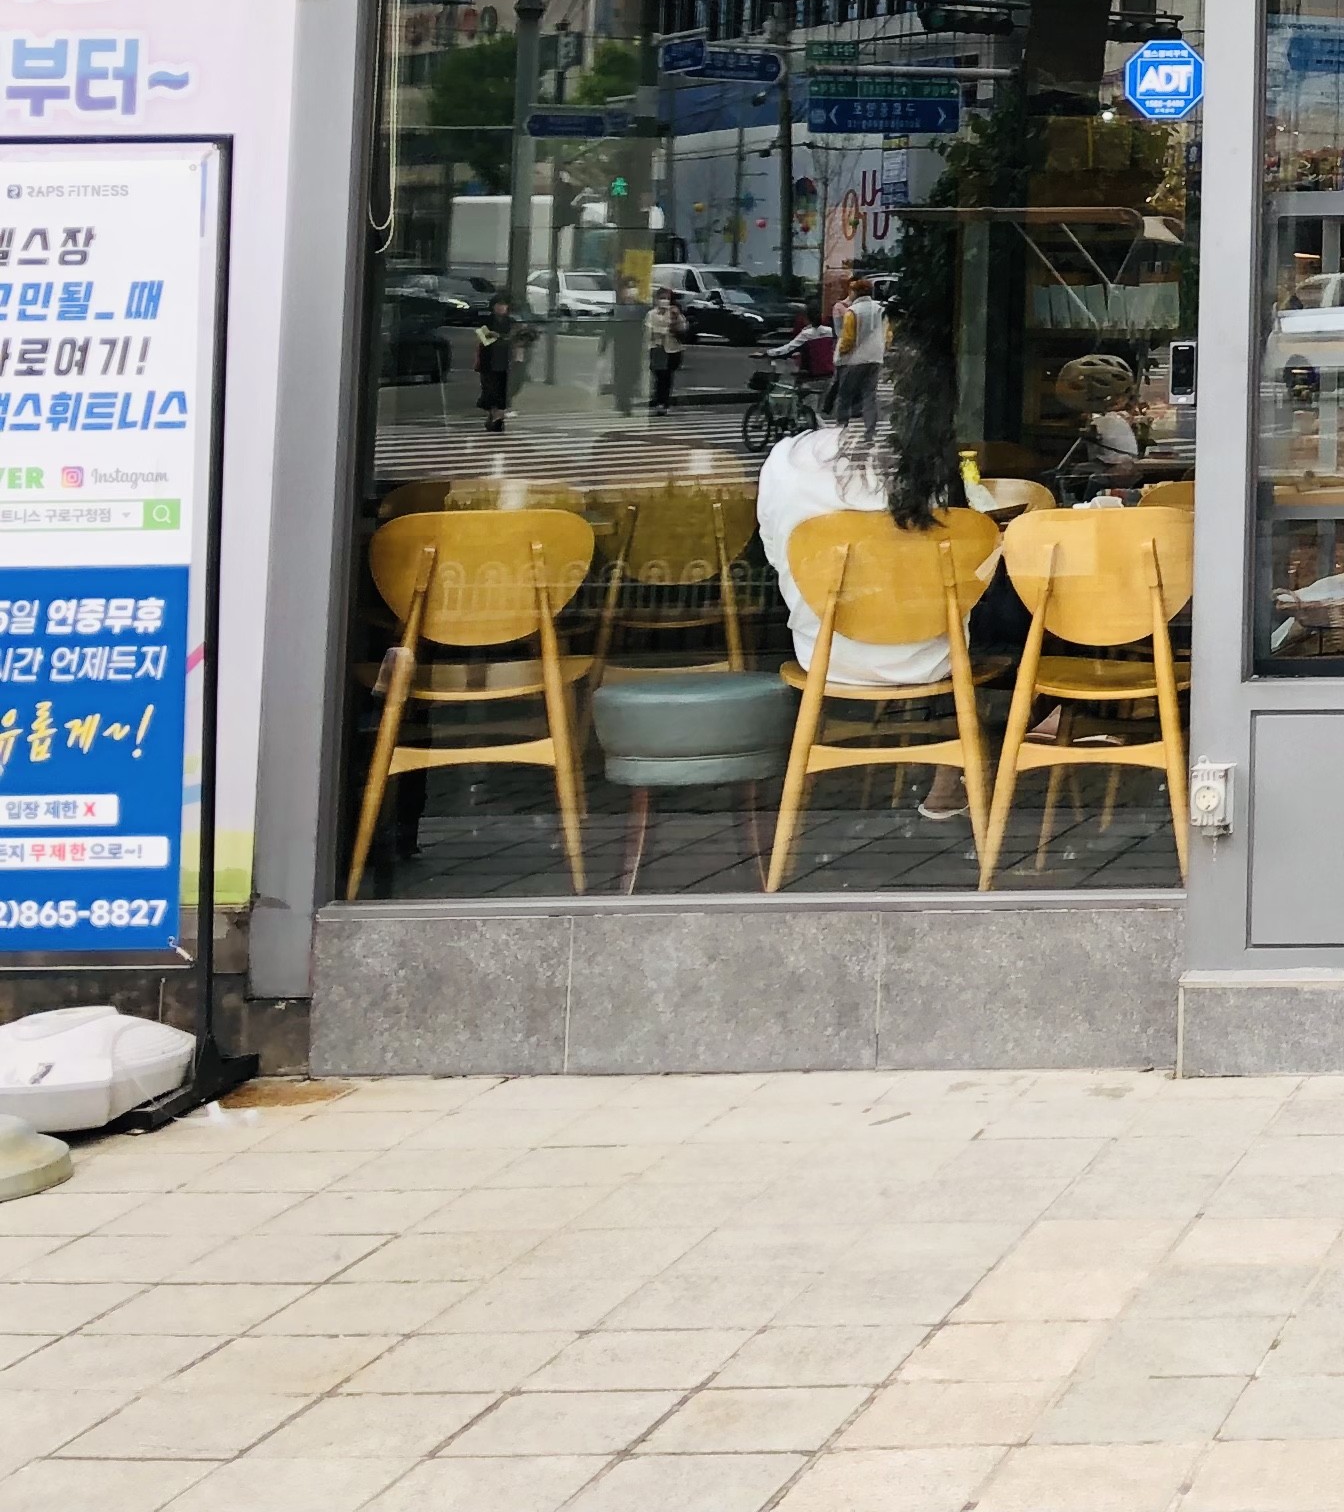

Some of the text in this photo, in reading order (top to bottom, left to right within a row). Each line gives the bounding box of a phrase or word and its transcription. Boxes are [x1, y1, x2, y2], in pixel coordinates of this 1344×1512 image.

[1139, 64, 1193, 93] ADT
[68, 184, 129, 197] FITNESS
[91, 467, 169, 490] Instagram
[45, 507, 112, 523] 구로구청점
[45, 597, 165, 635] 연중무휴
[50, 644, 168, 682] 언제든지
[5, 800, 40, 820] 입장
[44, 800, 79, 820] 제한
